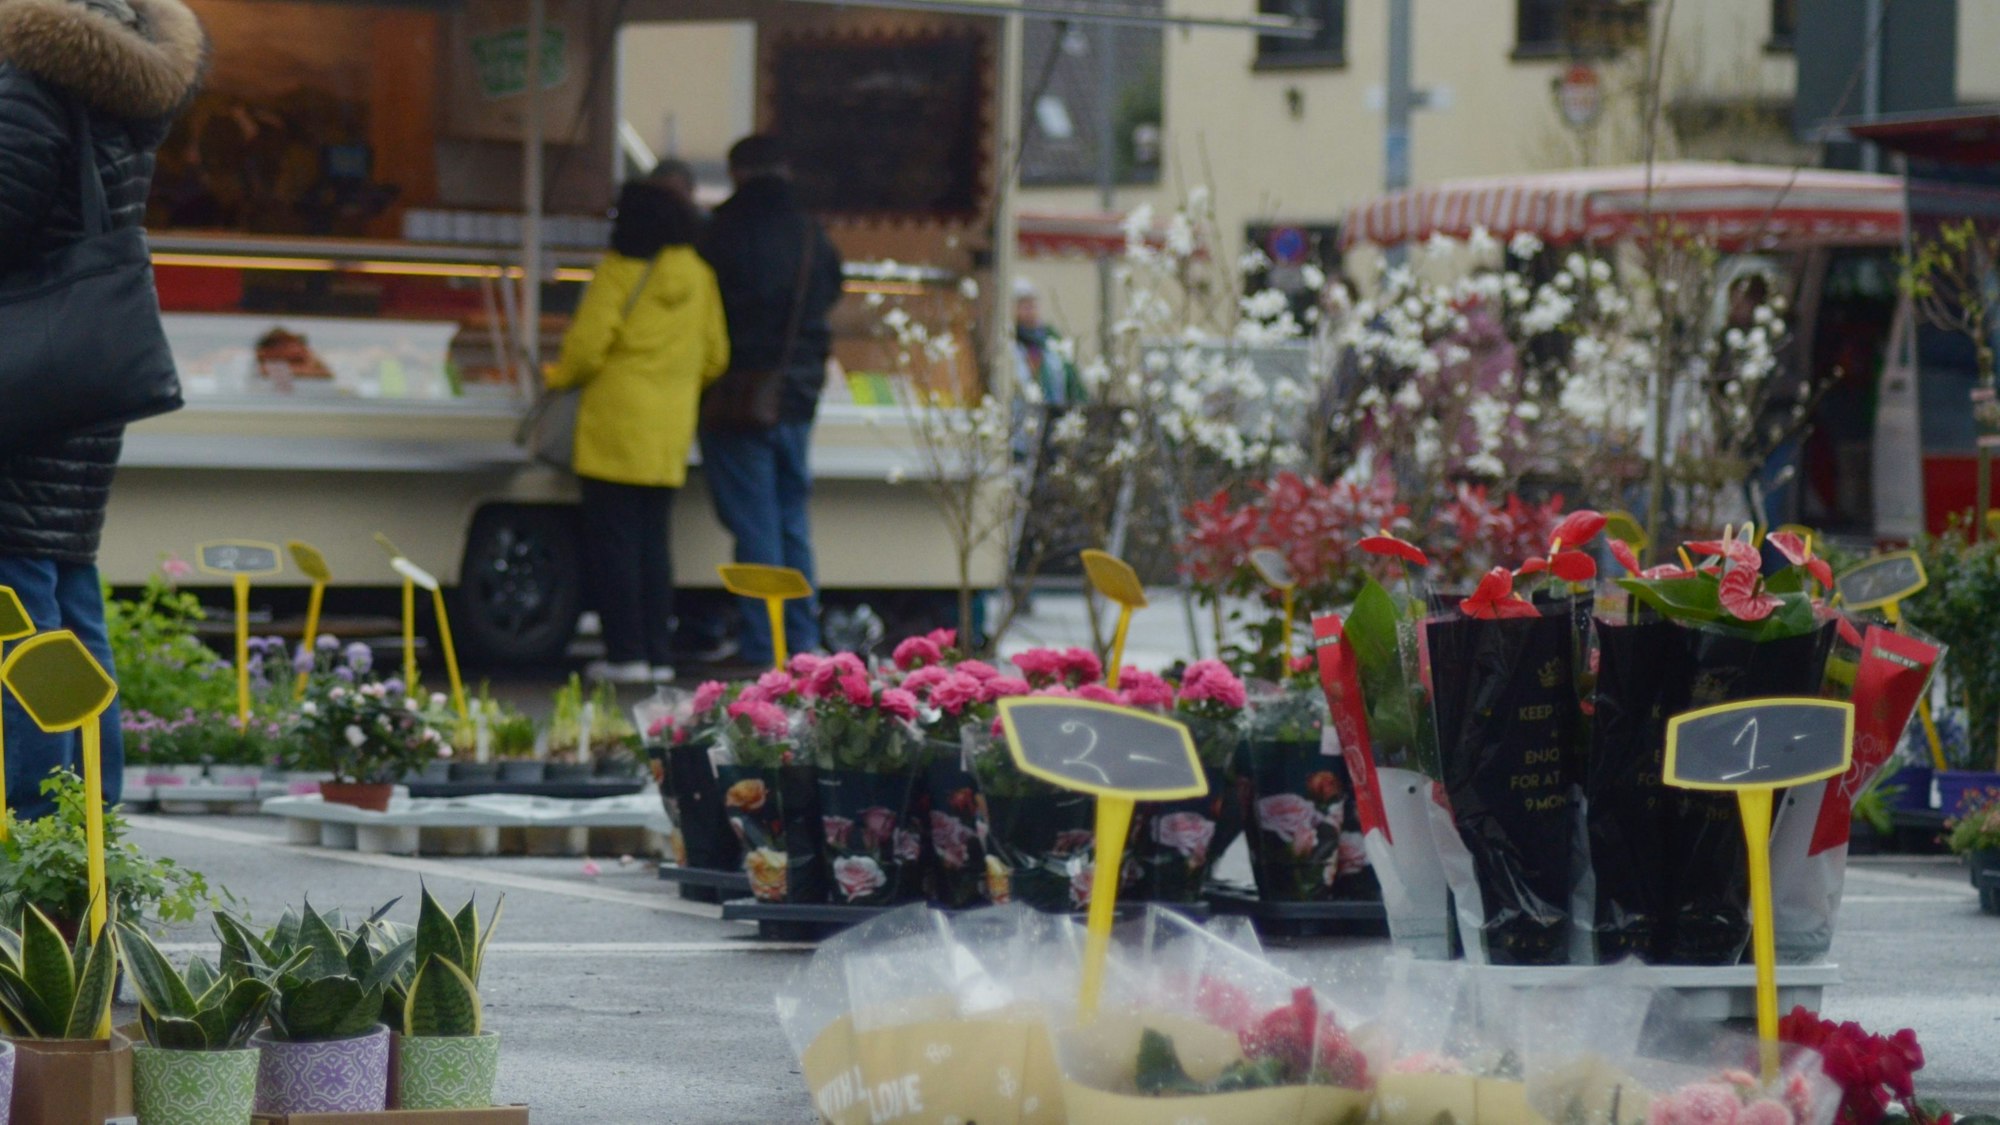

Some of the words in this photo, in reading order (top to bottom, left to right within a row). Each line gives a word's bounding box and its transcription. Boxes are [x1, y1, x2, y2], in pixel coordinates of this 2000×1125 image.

[1519, 704, 1553, 721] KEEP
[1511, 773, 1540, 790] FOR
[1543, 770, 1560, 785] AT
[1525, 798, 1533, 812] 9
[867, 1073, 924, 1125] LOVE
